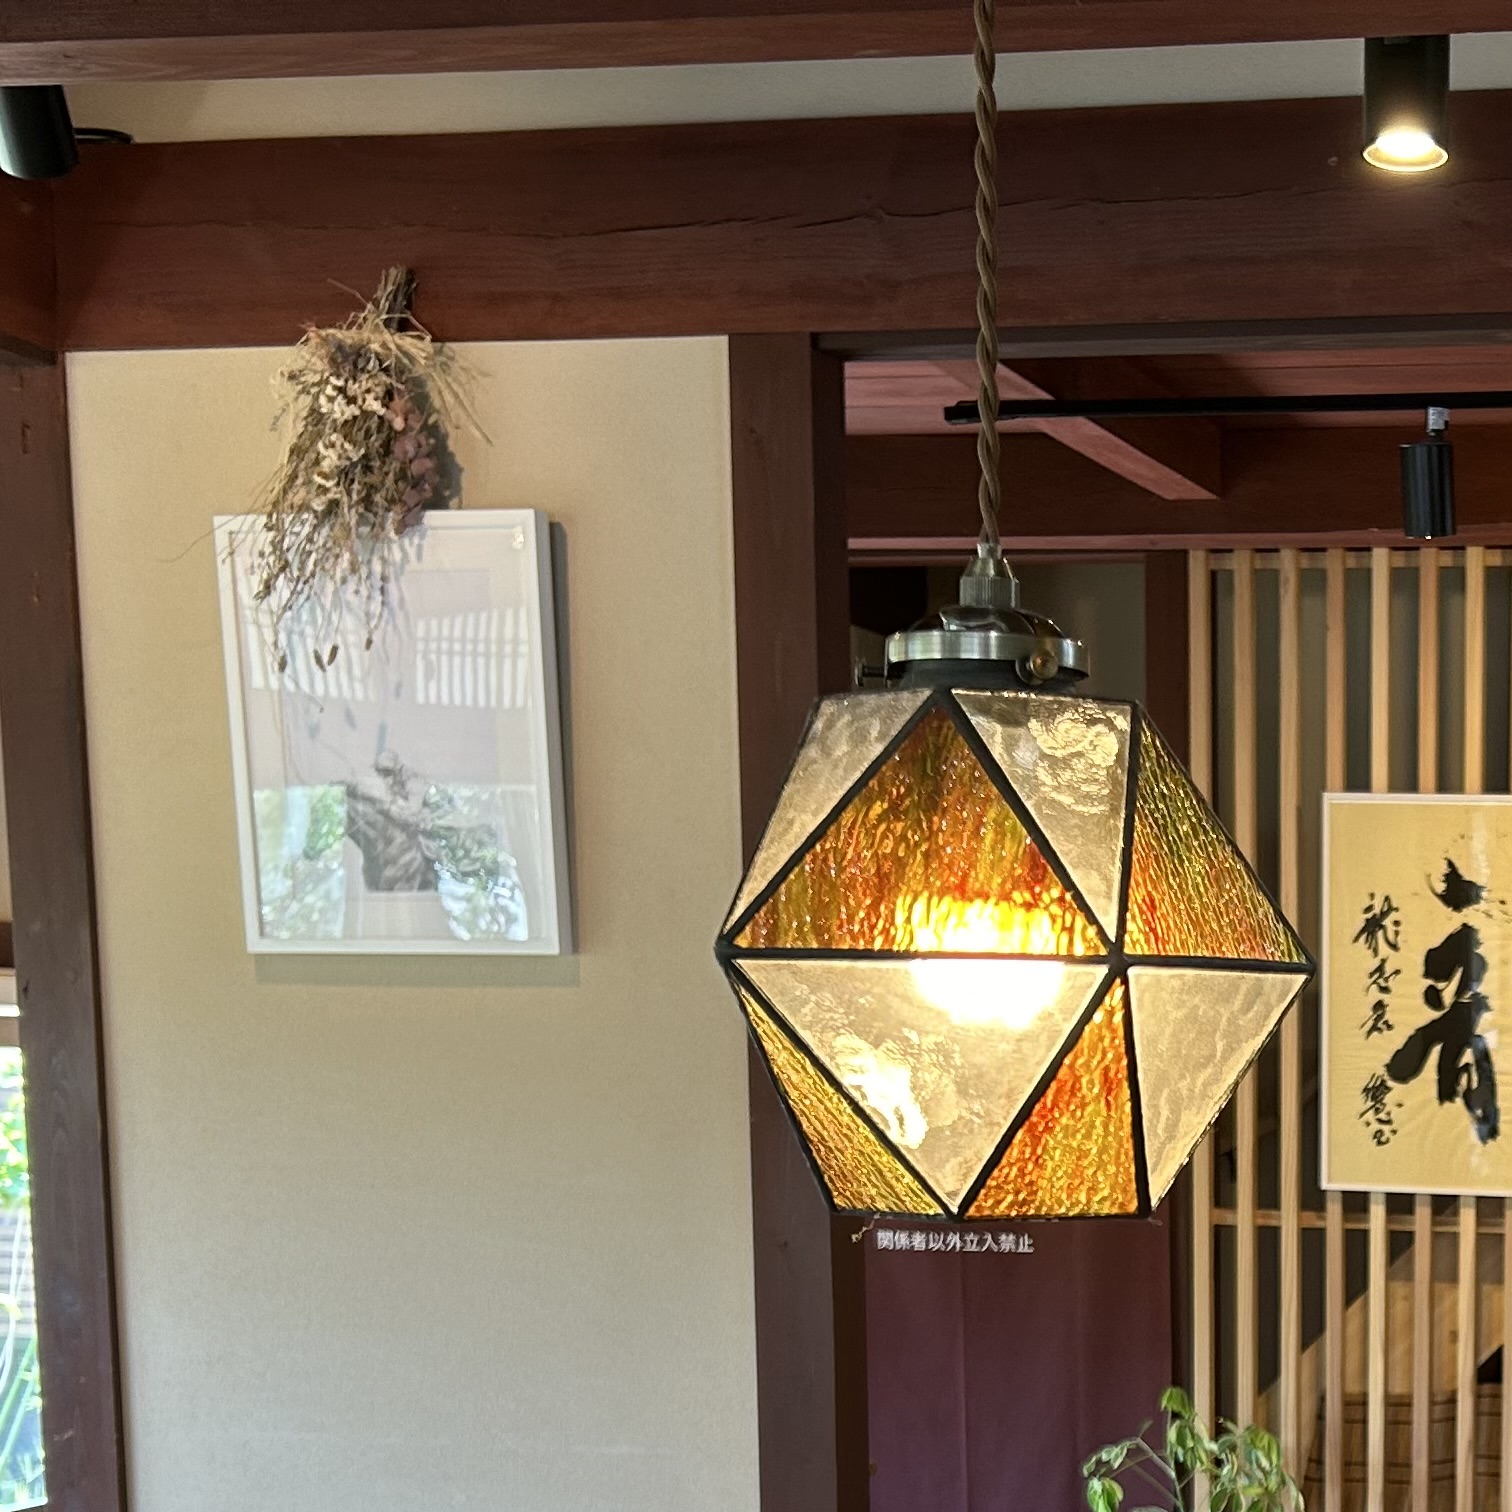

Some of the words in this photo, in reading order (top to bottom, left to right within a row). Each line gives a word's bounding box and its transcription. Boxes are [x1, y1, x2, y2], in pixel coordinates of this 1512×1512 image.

[876, 1228, 1035, 1254] 関係者以外立入禁止
